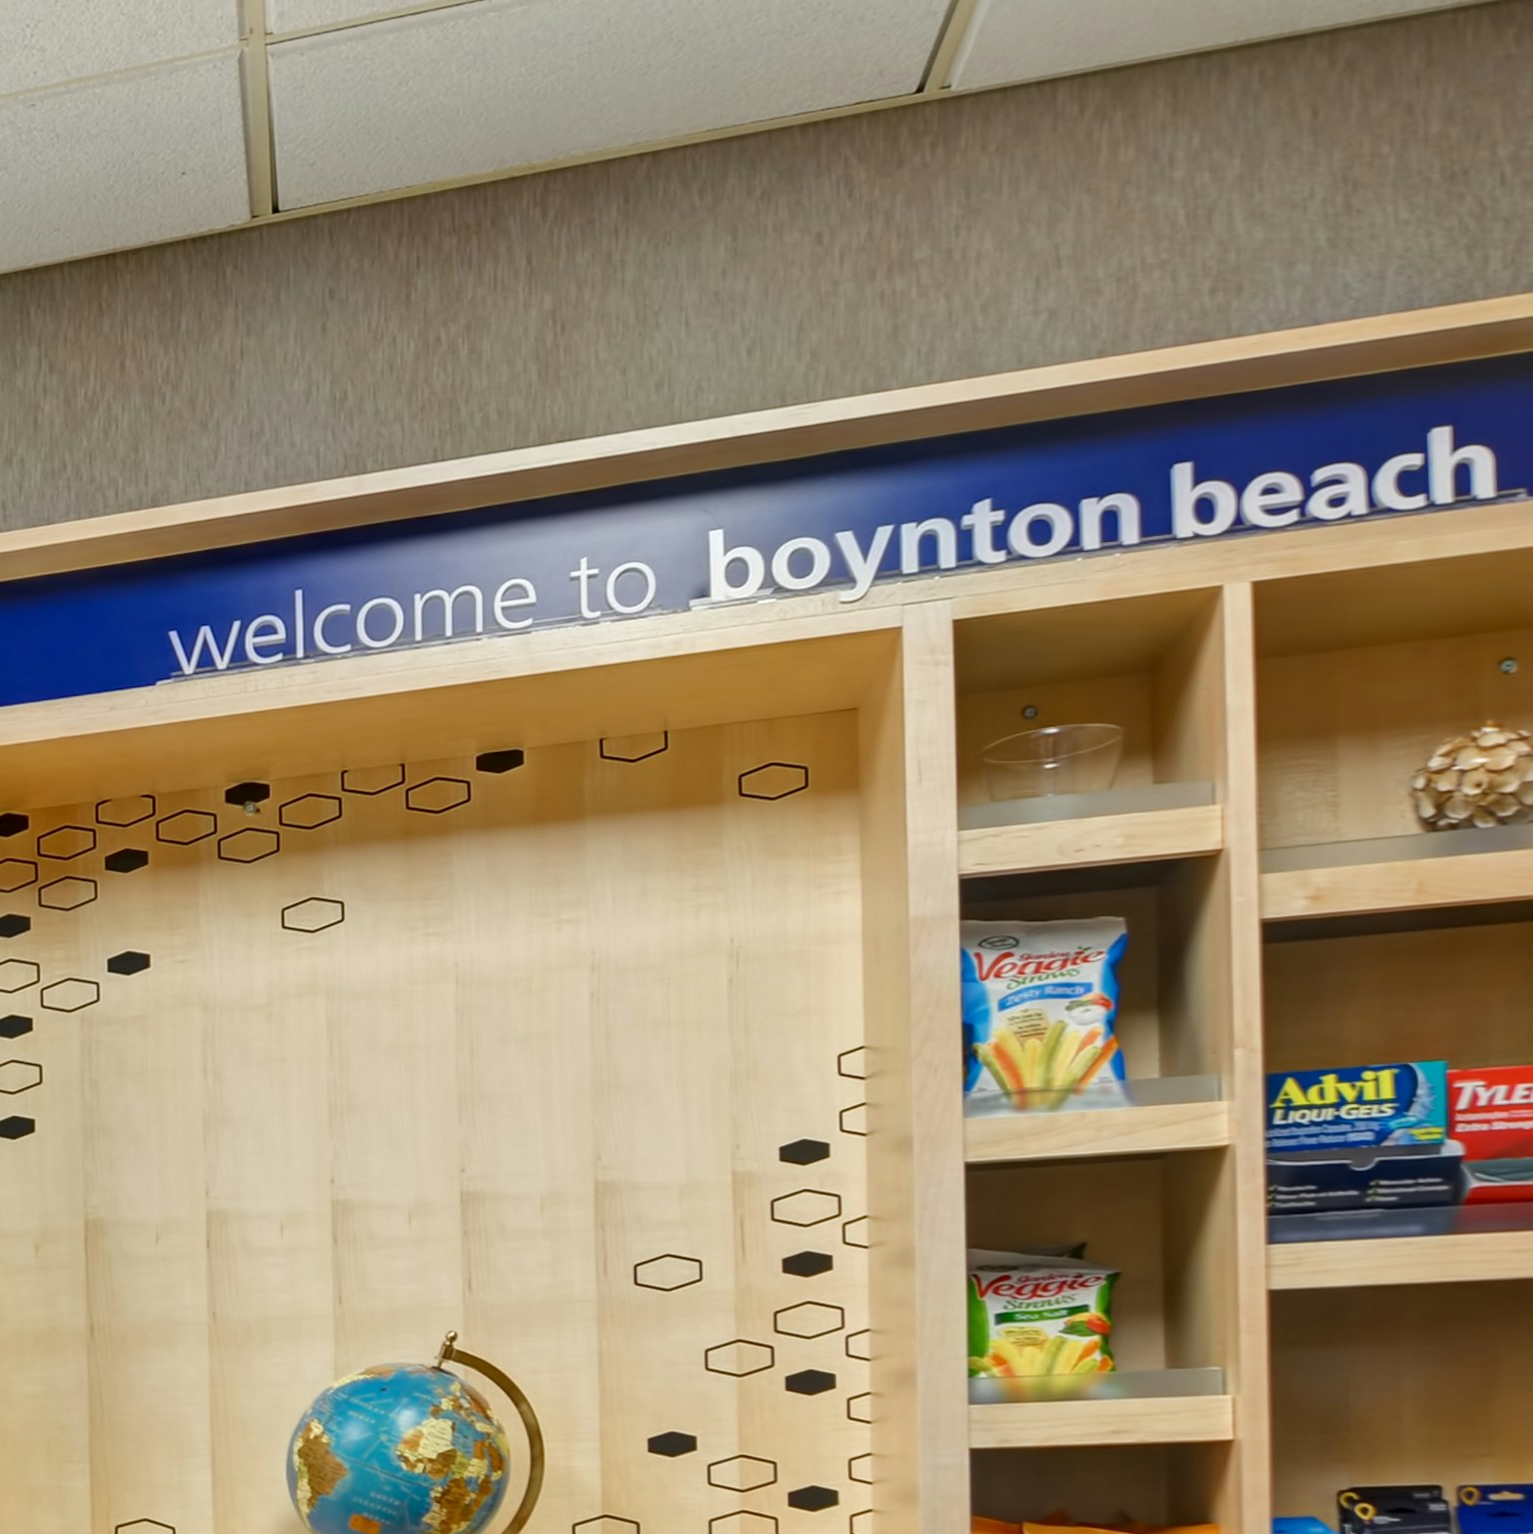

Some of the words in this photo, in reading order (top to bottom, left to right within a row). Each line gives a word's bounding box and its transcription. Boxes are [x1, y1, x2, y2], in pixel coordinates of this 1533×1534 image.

[168, 577, 537, 675] welcome
[570, 556, 656, 619] to
[708, 493, 1141, 602] boynton
[1170, 425, 1497, 539] beach
[974, 950, 1107, 981] Veggie
[1270, 1069, 1400, 1108] Advil
[1454, 1081, 1533, 1110] TYLE
[1273, 1103, 1399, 1125] LIQUI-GELS
[972, 1273, 1105, 1300] Veggie
